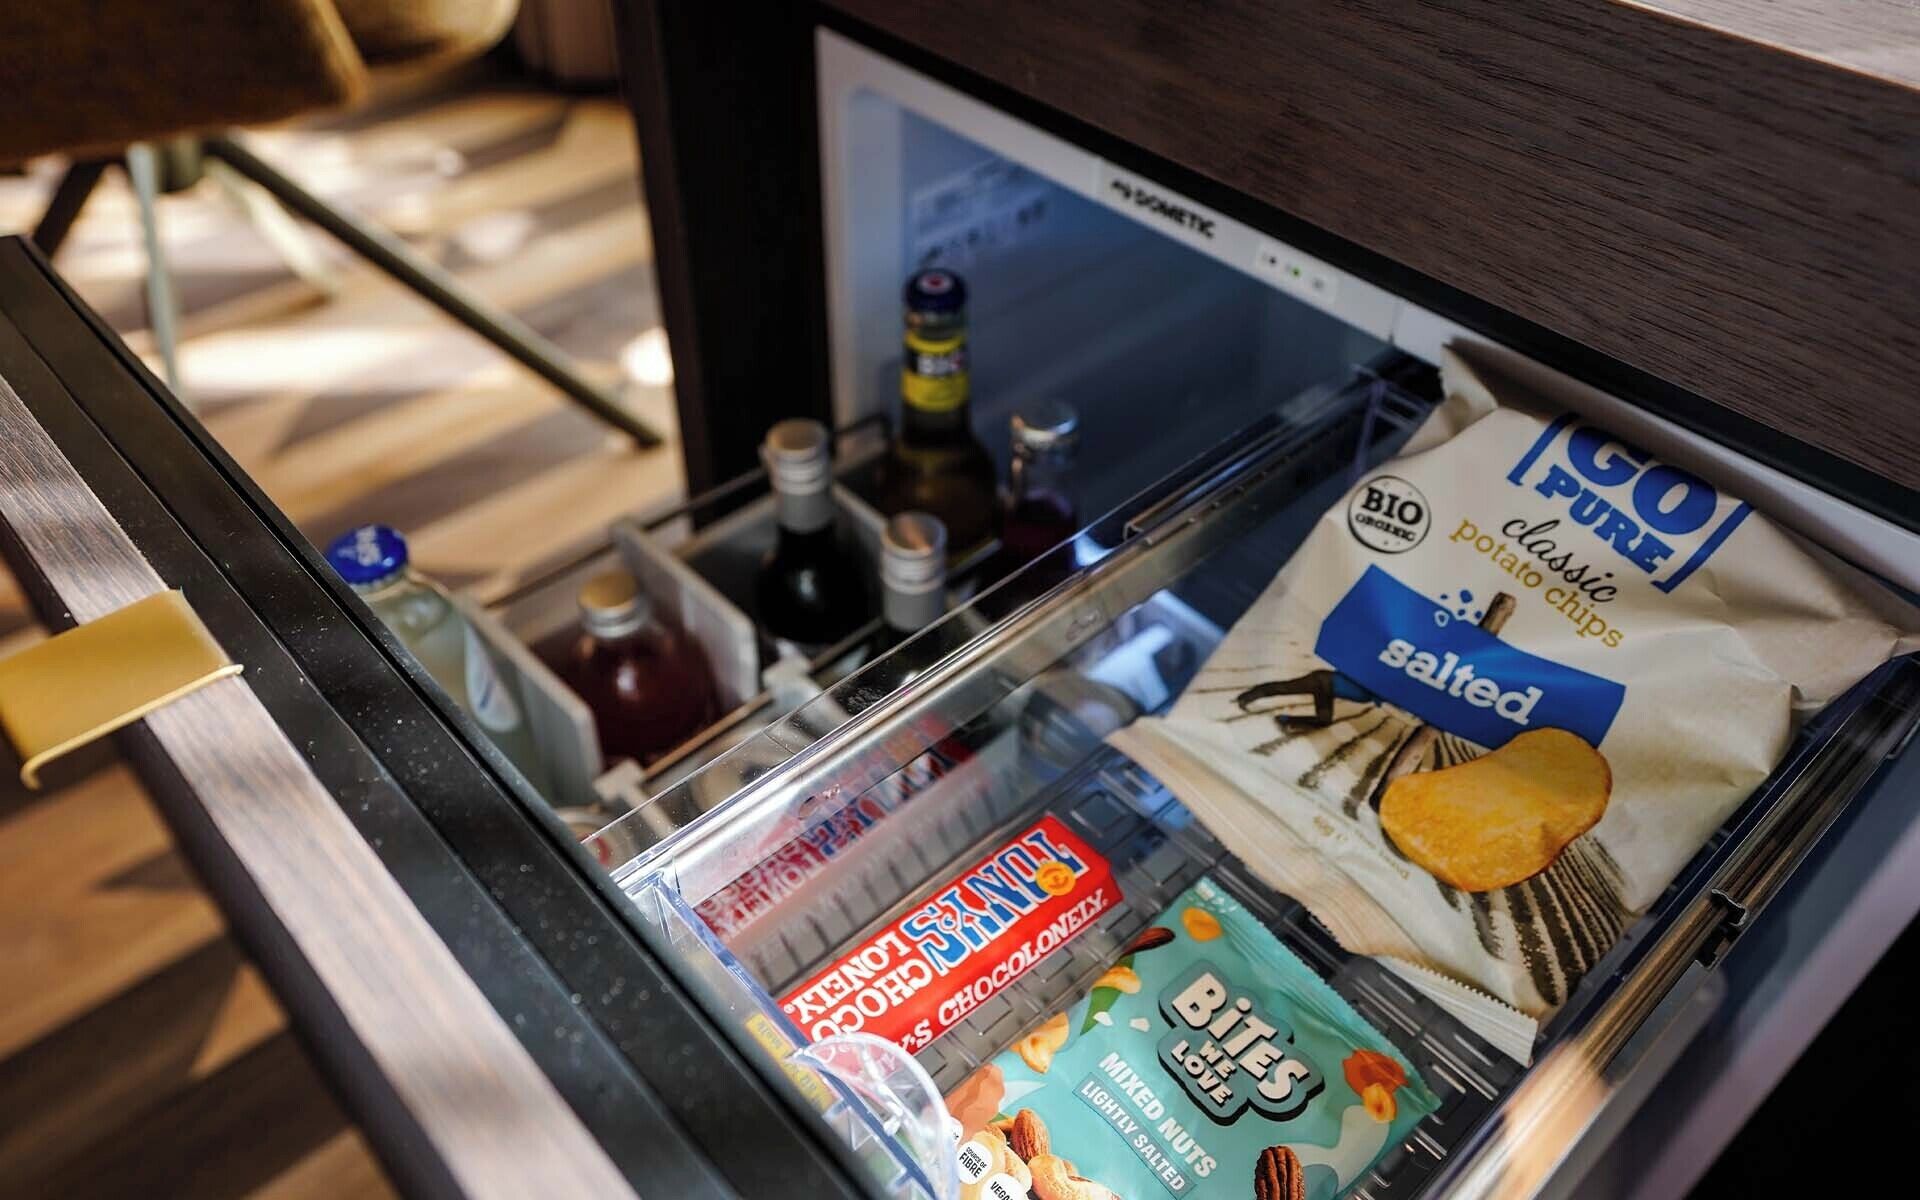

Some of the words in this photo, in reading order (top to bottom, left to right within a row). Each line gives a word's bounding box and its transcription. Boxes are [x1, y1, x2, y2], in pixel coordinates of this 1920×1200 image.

[1133, 189, 1215, 239] DOMETIC
[1360, 486, 1424, 527] BIO
[1535, 464, 1675, 574] PURE
[1567, 426, 1718, 535] GO
[1355, 513, 1416, 543] ORGANIC
[1502, 514, 1619, 604] classic
[1449, 518, 1543, 590] potato
[1544, 586, 1625, 649] chips
[1378, 638, 1544, 726] salted
[900, 828, 1089, 975] TONY'S
[811, 957, 934, 1044] CHOCO
[1171, 1040, 1234, 1105] LOVE
[1200, 1040, 1237, 1079] WE
[965, 1146, 982, 1164] SOURCE
[979, 1161, 988, 1169] OF
[1081, 1080, 1140, 1135] LIGHTLY
[1133, 1133, 1186, 1191] SALTED
[1099, 1052, 1165, 1121] MIXED
[1157, 1117, 1217, 1178] NUTS
[958, 1151, 983, 1178] FIBRE
[990, 1181, 1014, 1200] VEGA
